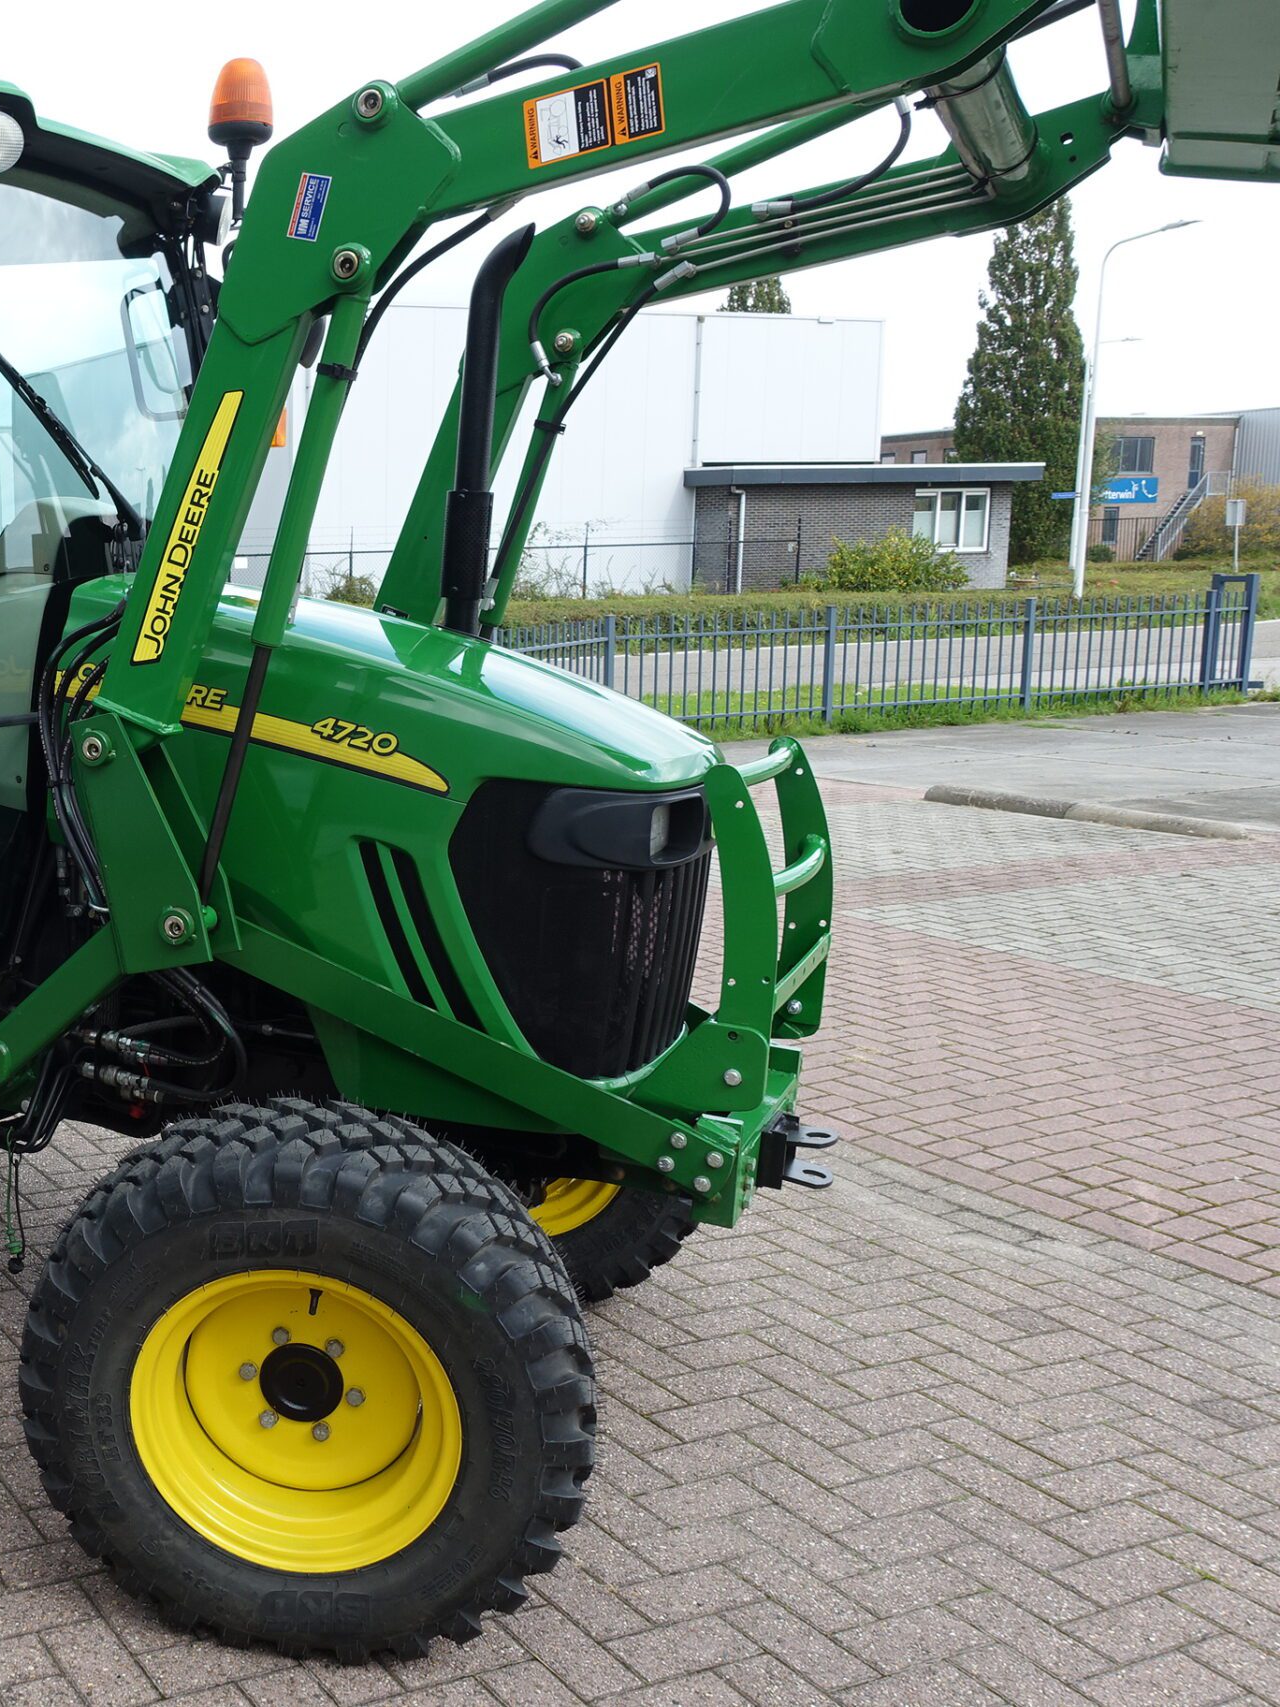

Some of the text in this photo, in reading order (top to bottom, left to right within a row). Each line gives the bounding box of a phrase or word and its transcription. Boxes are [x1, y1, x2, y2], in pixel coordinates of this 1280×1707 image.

[615, 81, 627, 124] WARNING
[527, 107, 538, 150] WARNING
[301, 178, 317, 217] SERVICE
[144, 469, 217, 655] JOHN DEERE
[312, 717, 399, 757] 4720
[209, 1219, 319, 1258] BKT
